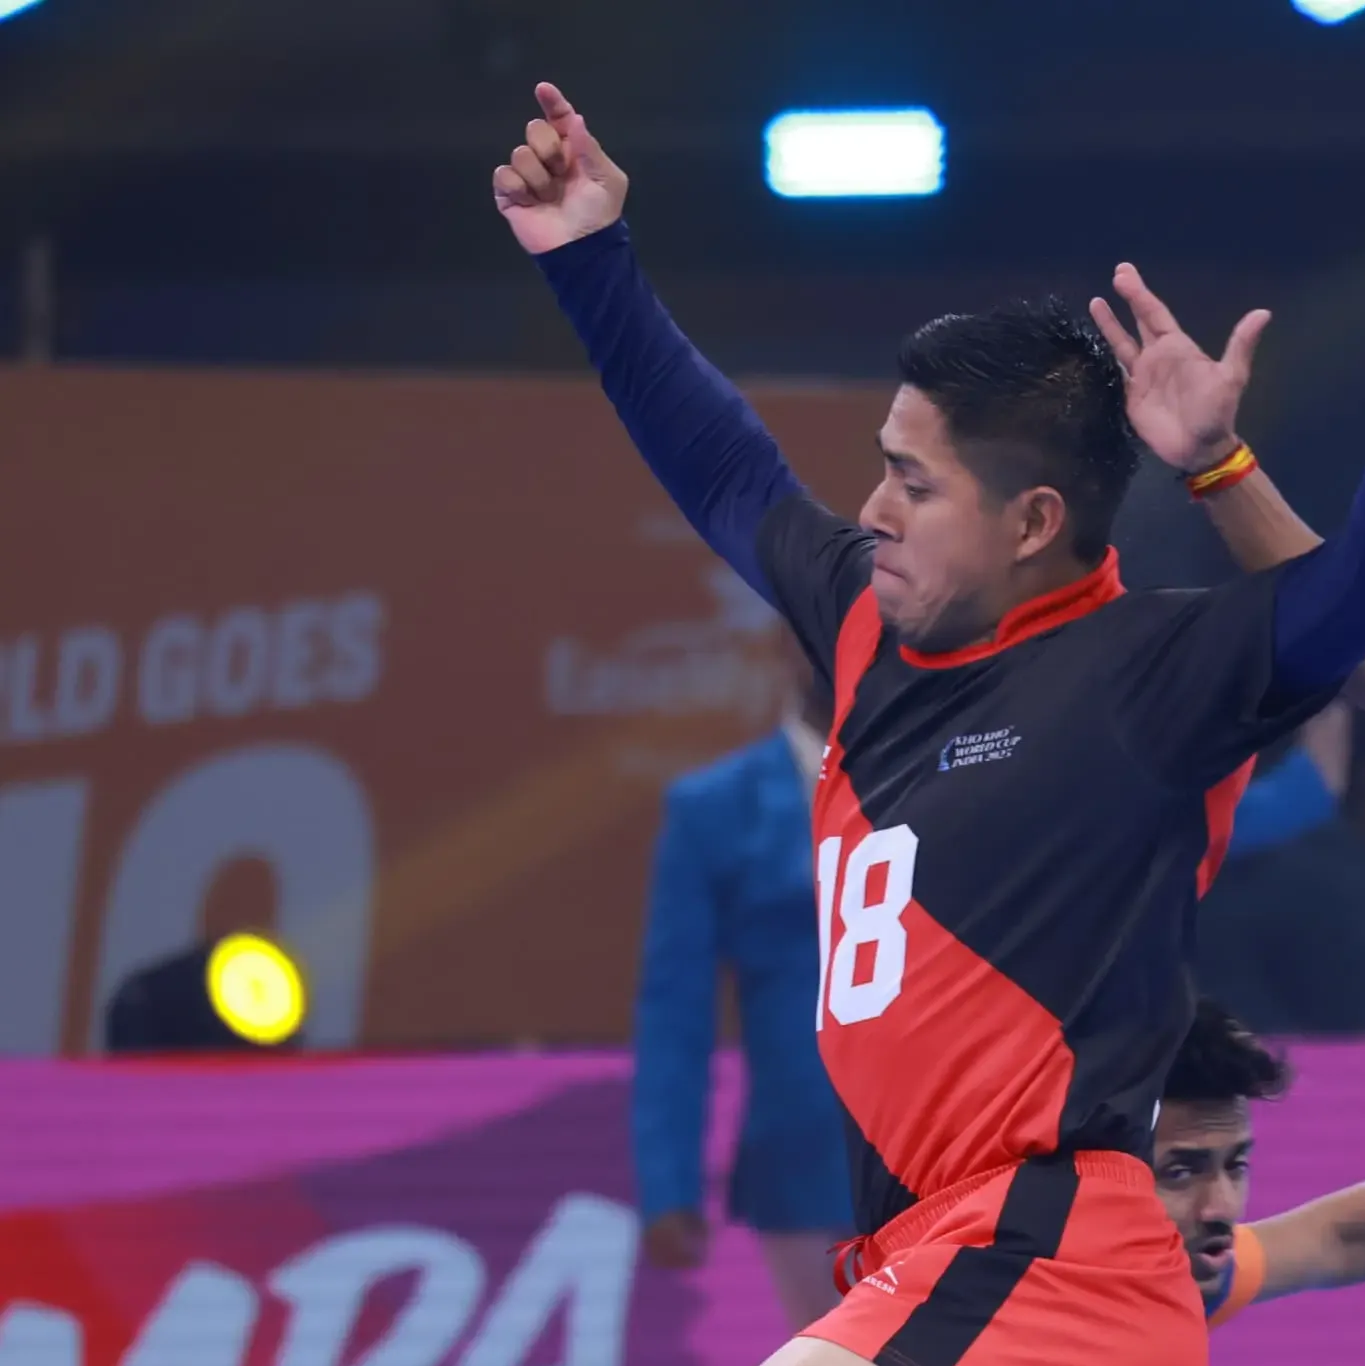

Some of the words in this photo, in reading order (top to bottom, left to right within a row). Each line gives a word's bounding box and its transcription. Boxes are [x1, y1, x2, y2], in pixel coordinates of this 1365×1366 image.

[0, 626, 120, 748] LD
[138, 588, 381, 727] GOES
[815, 823, 919, 1032] 18
